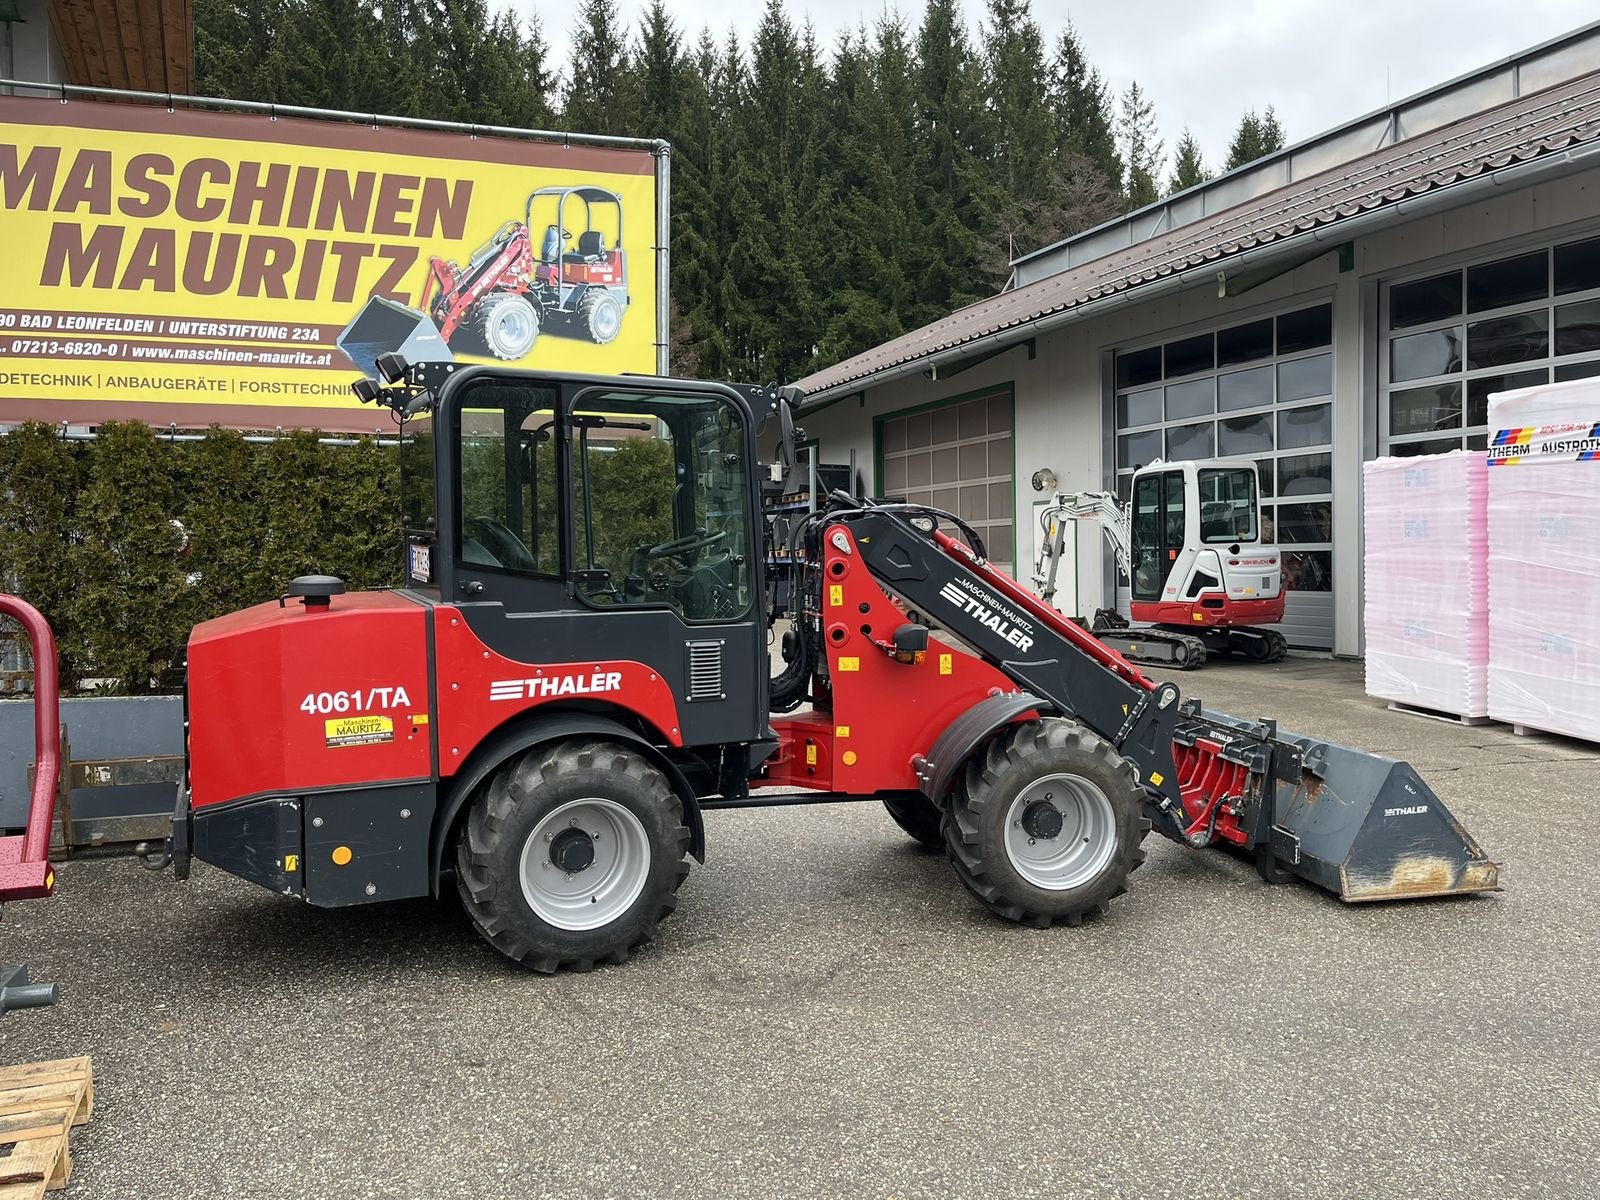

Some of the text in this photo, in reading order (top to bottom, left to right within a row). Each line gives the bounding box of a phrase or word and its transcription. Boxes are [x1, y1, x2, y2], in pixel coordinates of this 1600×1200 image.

[0, 144, 474, 240] MASCHINEN
[40, 222, 419, 305] MAURITZ
[20, 315, 52, 328] BAD
[57, 316, 154, 332] LEONFELDEN
[169, 321, 288, 339] UNTERSTIFTUNG
[291, 328, 320, 341] 23A
[12, 340, 118, 356] 07213-6820-0
[132, 346, 332, 366] www.maschinen-mauritz.at
[0, 373, 93, 387] DETECHNIK
[105, 376, 227, 391] ANBAUGERÄTE
[964, 597, 1034, 653] THALER
[525, 672, 622, 698] THALER
[300, 686, 411, 714] 4061/TA
[336, 723, 382, 735] MAURITZ
